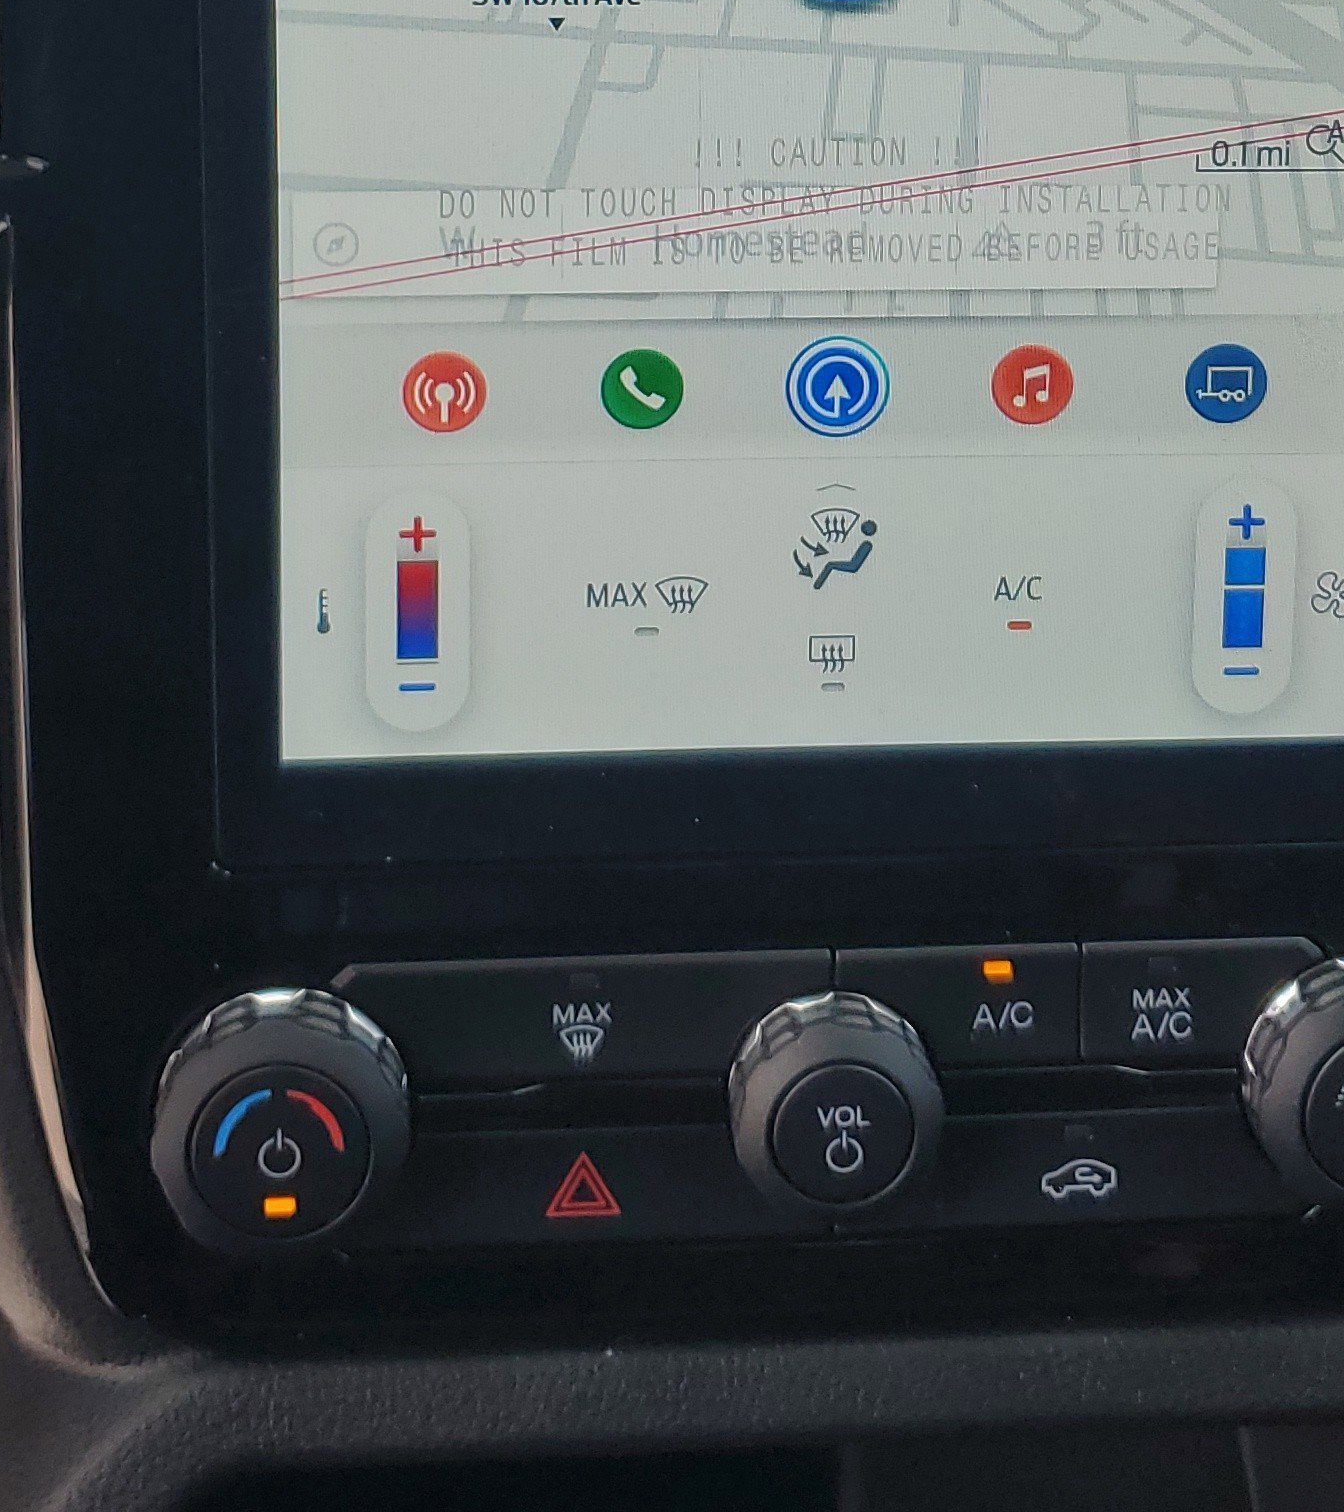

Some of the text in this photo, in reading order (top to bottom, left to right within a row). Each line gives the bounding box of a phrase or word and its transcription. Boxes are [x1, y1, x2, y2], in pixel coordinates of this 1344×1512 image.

[770, 137, 906, 167] CAUTION
[1256, 140, 1290, 167] mi
[440, 183, 1233, 219] DO NOT TOUCH DISPLAY DURING INSTALLATION
[549, 237, 626, 267] FILM
[828, 233, 964, 264] REMOVED
[587, 582, 647, 609] MAX
[994, 575, 1043, 602] A/C
[1132, 987, 1191, 1011] MAX
[552, 1002, 612, 1025] MAX
[972, 1000, 1035, 1031] A/C
[1131, 1011, 1194, 1042] A/C
[816, 1105, 871, 1129] VOL
